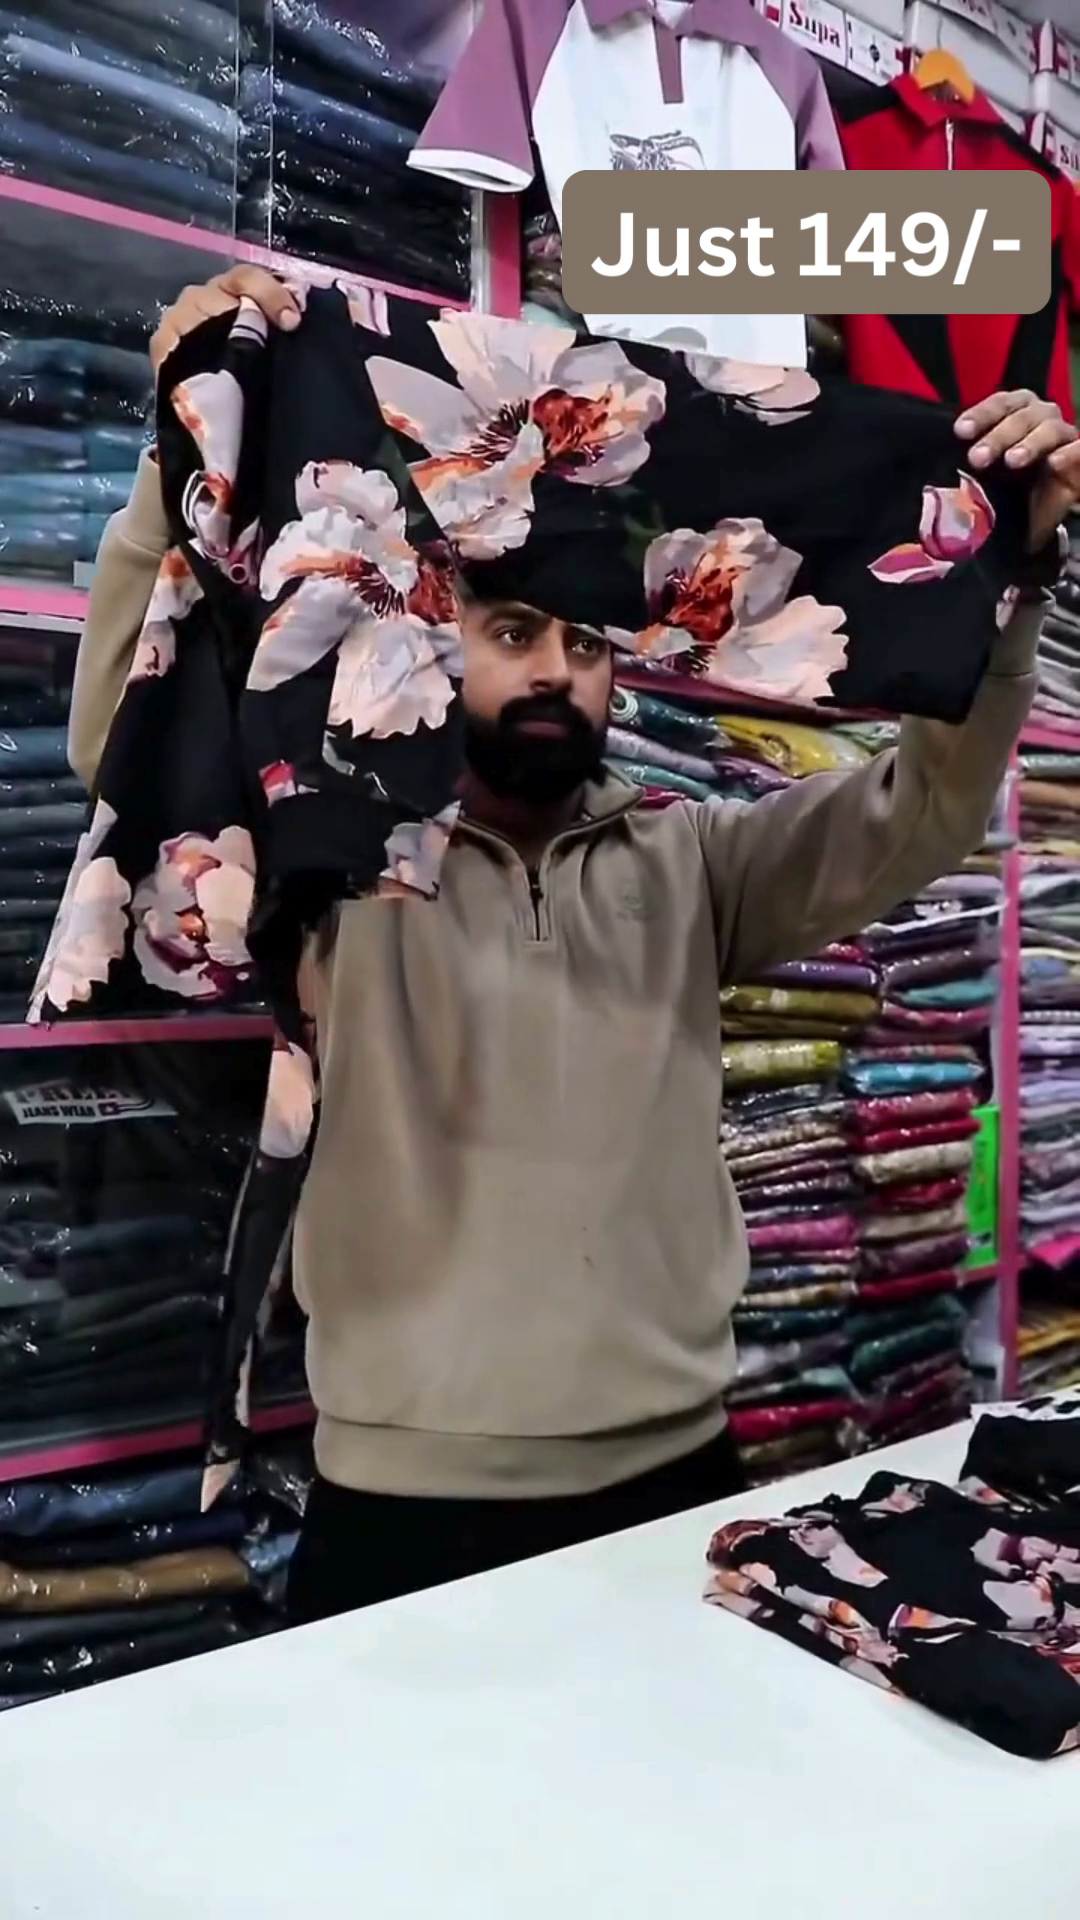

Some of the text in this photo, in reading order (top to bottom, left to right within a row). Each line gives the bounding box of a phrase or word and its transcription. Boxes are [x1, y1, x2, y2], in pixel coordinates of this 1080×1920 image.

[789, 1, 841, 48] Supa
[22, 1104, 95, 1118] JEANS WEAR
